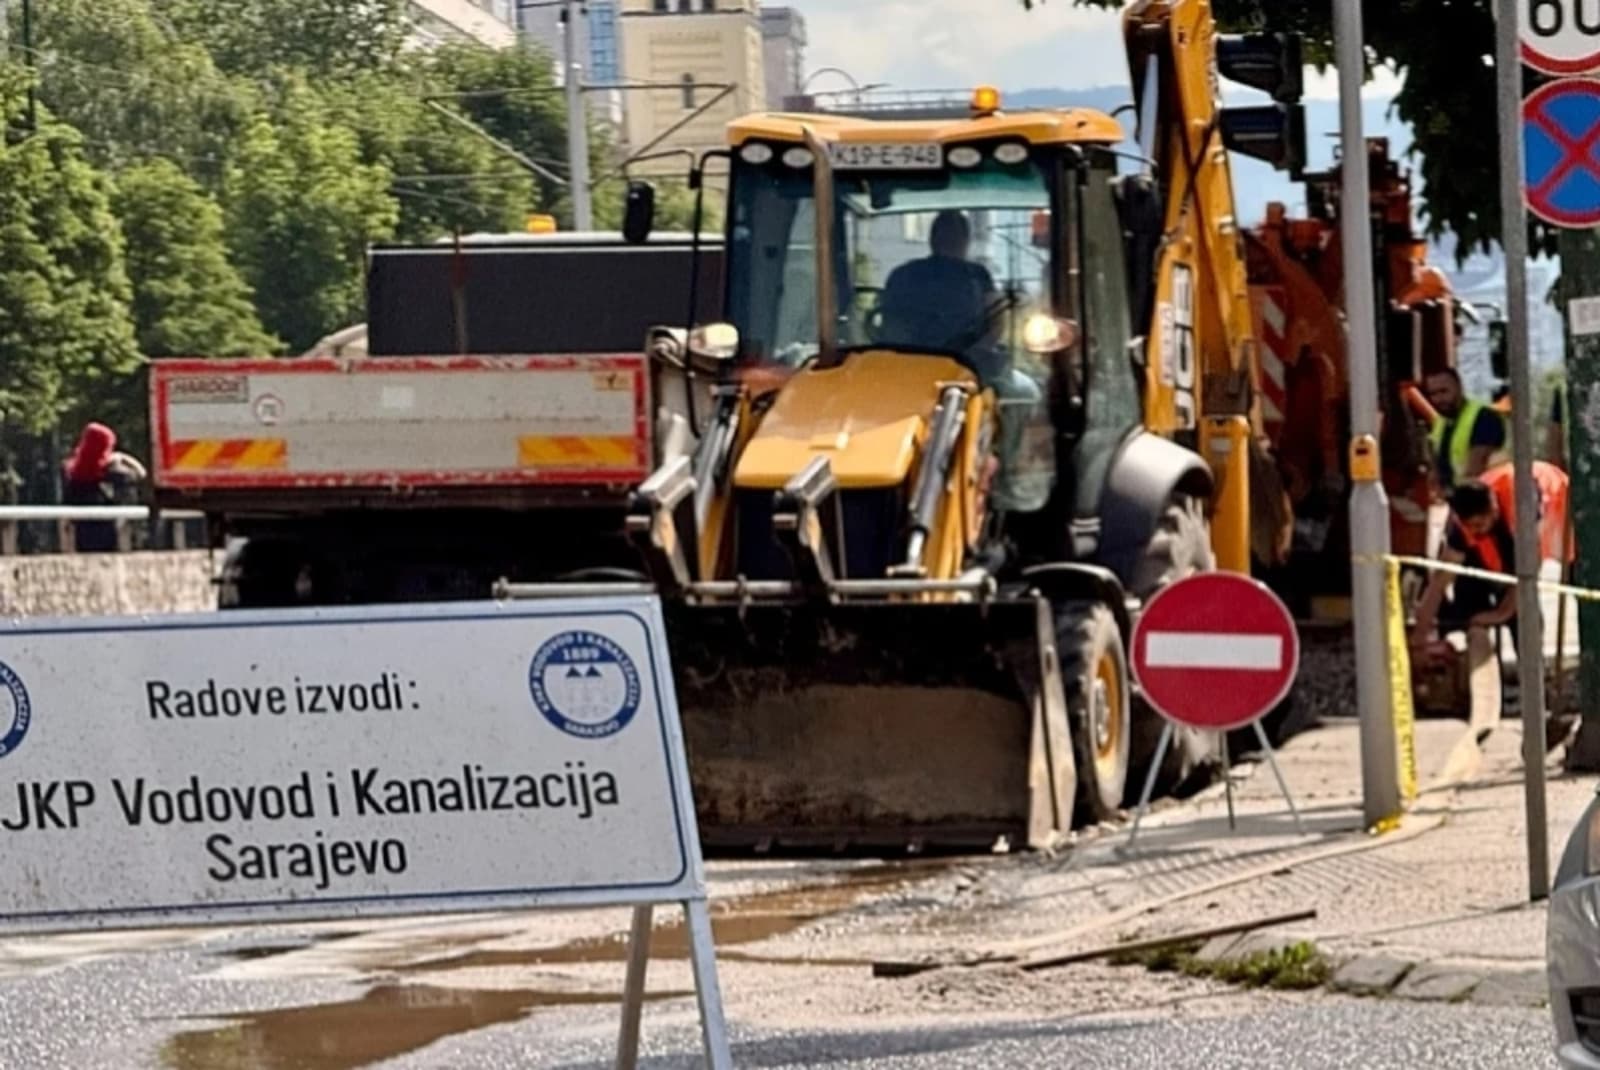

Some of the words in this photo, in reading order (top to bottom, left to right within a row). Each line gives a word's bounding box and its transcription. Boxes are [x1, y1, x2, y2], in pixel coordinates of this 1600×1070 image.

[147, 680, 286, 720] Radove
[2, 781, 95, 832] JKP
[112, 772, 315, 826] Vodovod
[327, 770, 339, 818] i
[352, 762, 619, 819] Kanalizacija
[206, 832, 407, 891] Sarajevo
